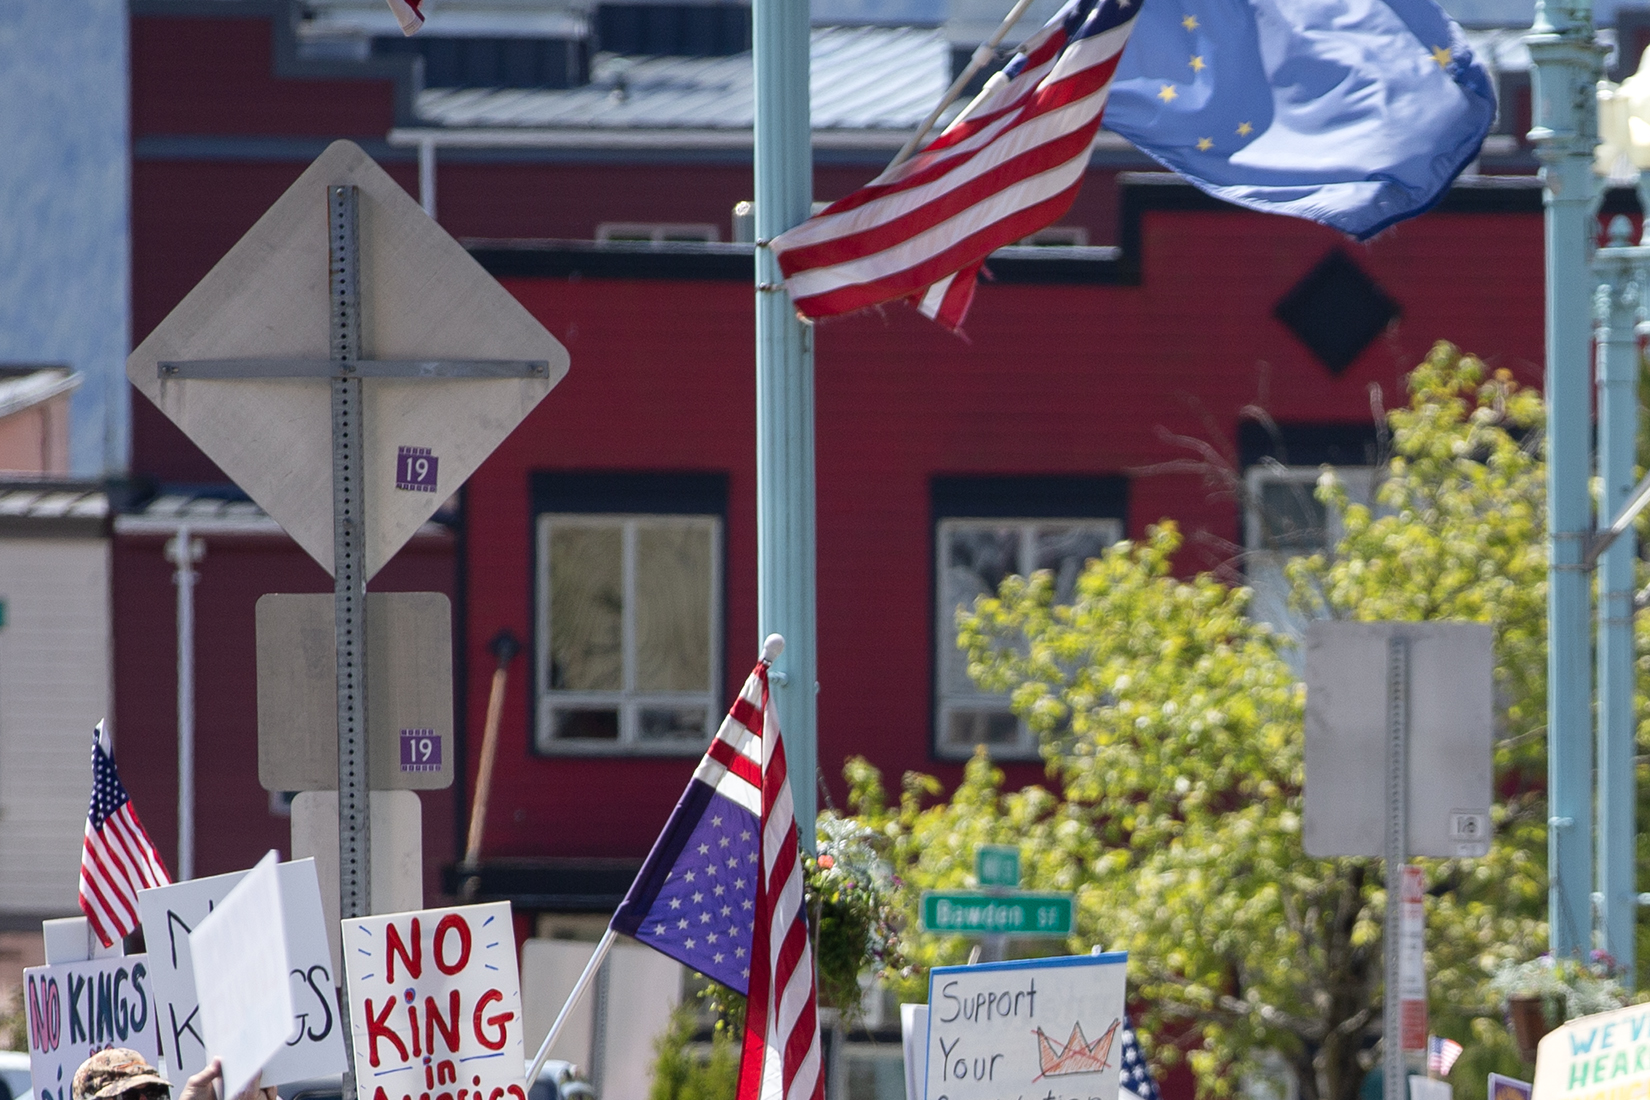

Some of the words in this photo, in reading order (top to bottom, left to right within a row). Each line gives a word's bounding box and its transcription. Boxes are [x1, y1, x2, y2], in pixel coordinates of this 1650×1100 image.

[405, 456, 430, 483] 19
[409, 737, 433, 763] 19
[936, 899, 1025, 928] Bawden
[386, 913, 472, 985] NO
[28, 973, 61, 1054] NO
[67, 962, 148, 1046] KINGS
[168, 965, 333, 1071] KGS
[939, 977, 1037, 1024] Support
[423, 1055, 457, 1091] in
[939, 1036, 1004, 1082] Your
